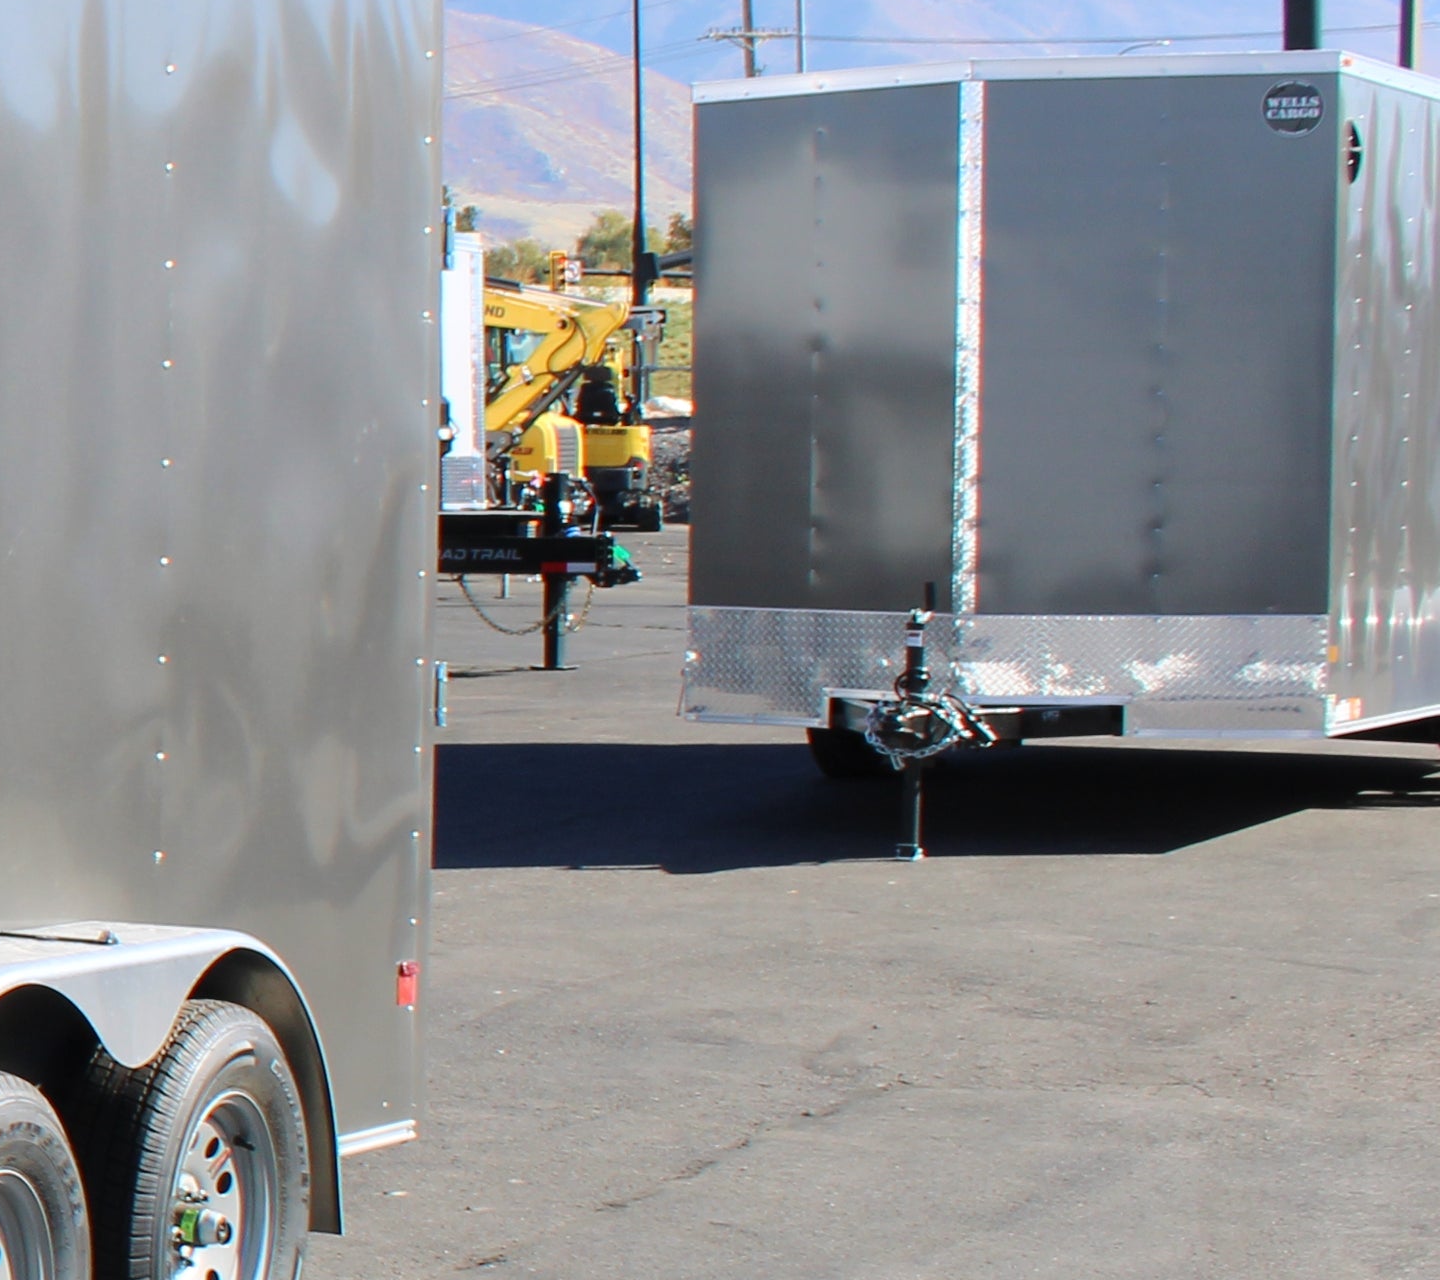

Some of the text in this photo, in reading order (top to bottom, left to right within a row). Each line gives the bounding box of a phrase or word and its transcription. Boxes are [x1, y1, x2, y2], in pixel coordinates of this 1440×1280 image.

[1266, 96, 1321, 108] WELLS
[1266, 108, 1321, 119] CARGO
[471, 548, 523, 560] TRAIL
